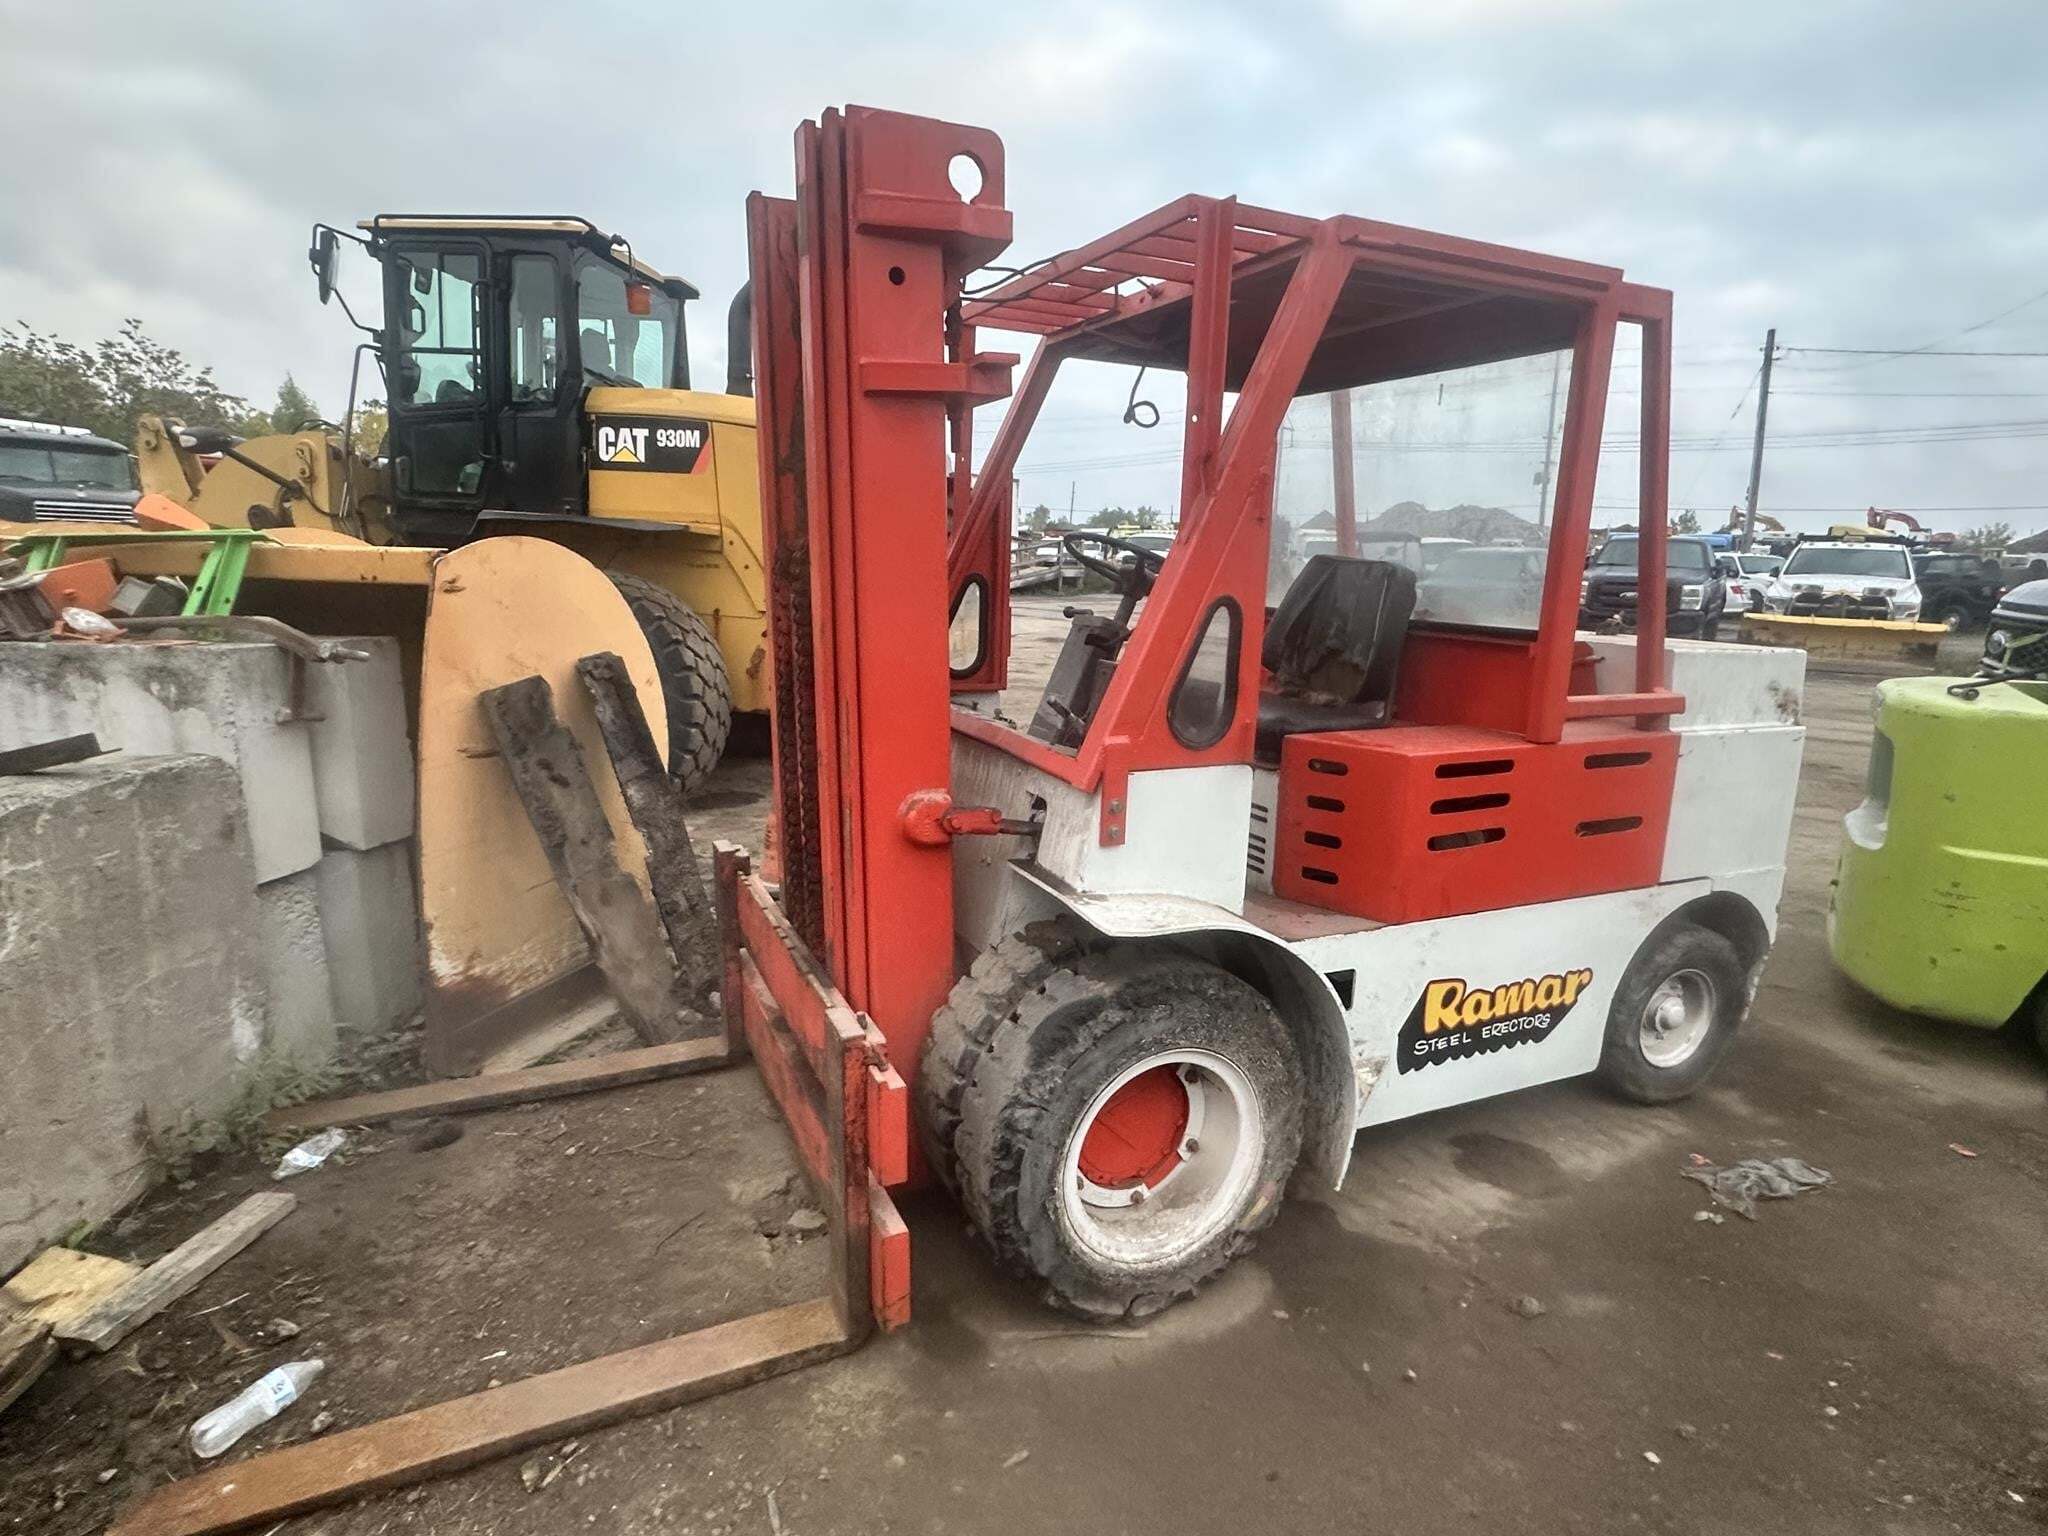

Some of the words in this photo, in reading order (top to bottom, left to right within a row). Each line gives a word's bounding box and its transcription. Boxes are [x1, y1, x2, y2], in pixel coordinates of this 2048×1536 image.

[598, 426, 649, 463] CAT
[656, 429, 701, 448] 930M
[1424, 968, 1593, 1034] Ramar
[1413, 1031, 1472, 1056] STEEL
[1482, 1013, 1551, 1038] ERECTORS
